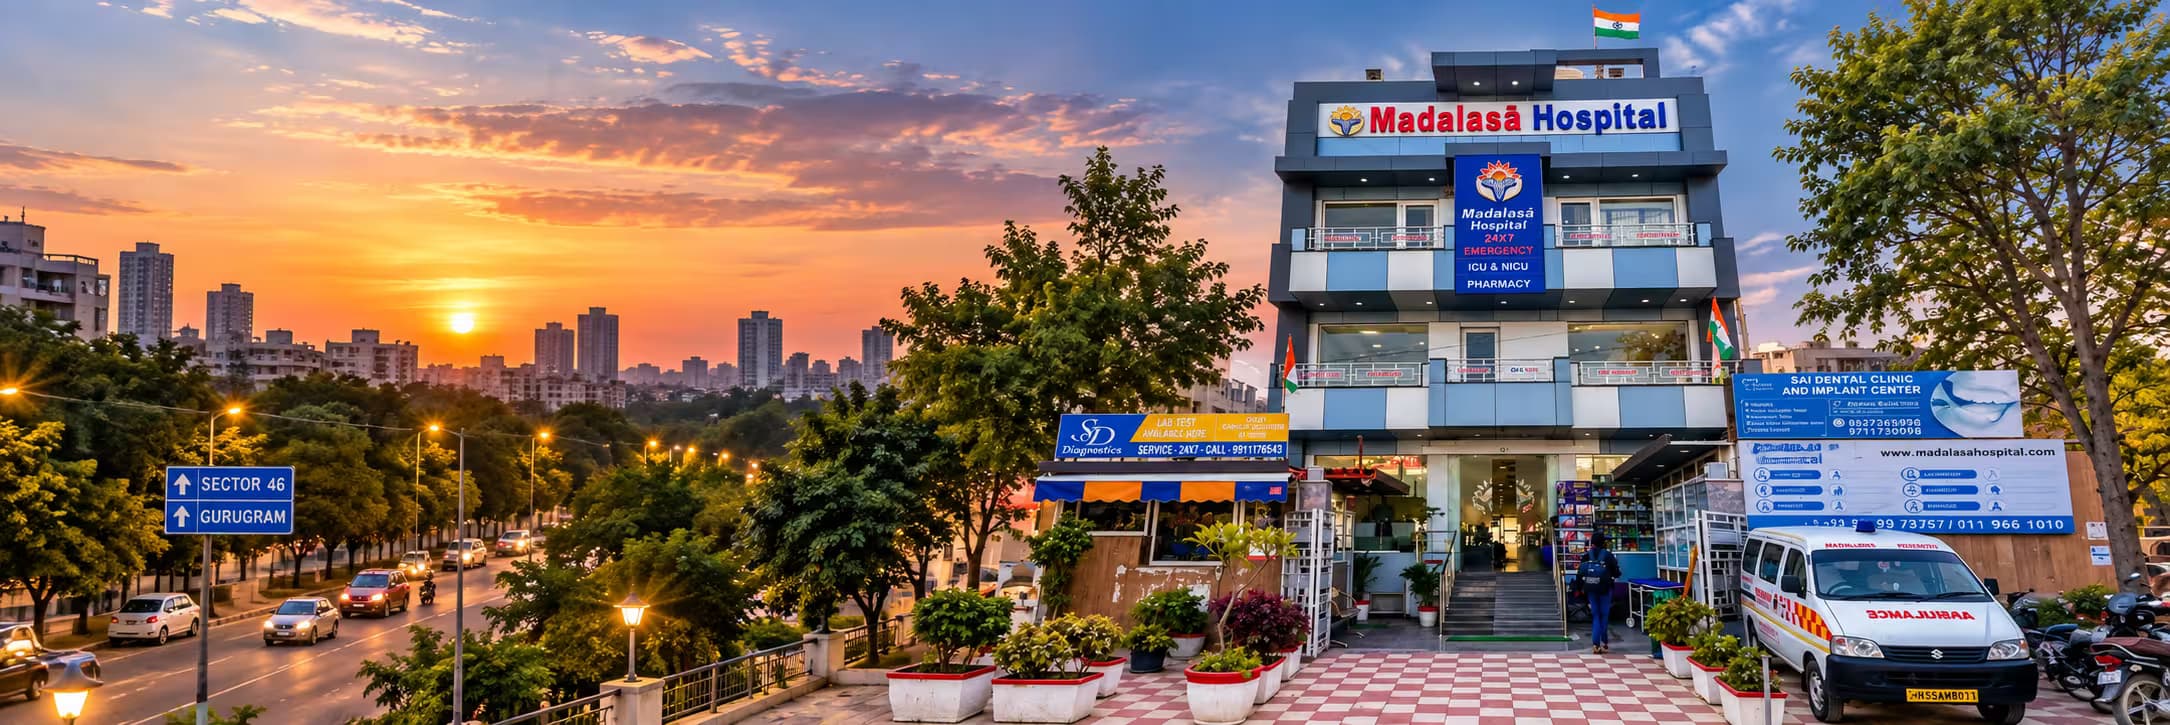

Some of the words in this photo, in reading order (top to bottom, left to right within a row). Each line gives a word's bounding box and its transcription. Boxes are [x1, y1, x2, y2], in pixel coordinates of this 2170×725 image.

[1533, 102, 1667, 135] Hospital
[1470, 220, 1528, 232] Hospital
[1484, 233, 1515, 243] 24X7
[1463, 246, 1534, 256] EMERGENCY
[1468, 262, 1487, 272] ICU
[1490, 262, 1498, 271] &
[1501, 262, 1529, 271] NICU
[1467, 279, 1531, 288] PHARMACY
[1791, 375, 1812, 385] SAI
[1815, 375, 1866, 384] DENTAL
[1870, 374, 1914, 384] CLINIC
[1782, 386, 1809, 396] AND
[1812, 386, 1867, 395] IMPLANT
[1871, 385, 1921, 395] CENTER
[1176, 417, 1197, 427] TEST
[1070, 418, 1116, 446] SD
[1062, 445, 1122, 457] Diagnostics
[1137, 444, 1174, 455] SERVICE
[1205, 444, 1226, 455] CALL
[1880, 446, 2056, 459] www.madalasahospital.com
[201, 478, 260, 491] SECTOR
[267, 478, 285, 491] 46
[201, 510, 286, 524] GURUGRAM
[1957, 519, 1985, 530] 011
[1991, 519, 2021, 530] 966
[2026, 518, 2064, 530] 1010
